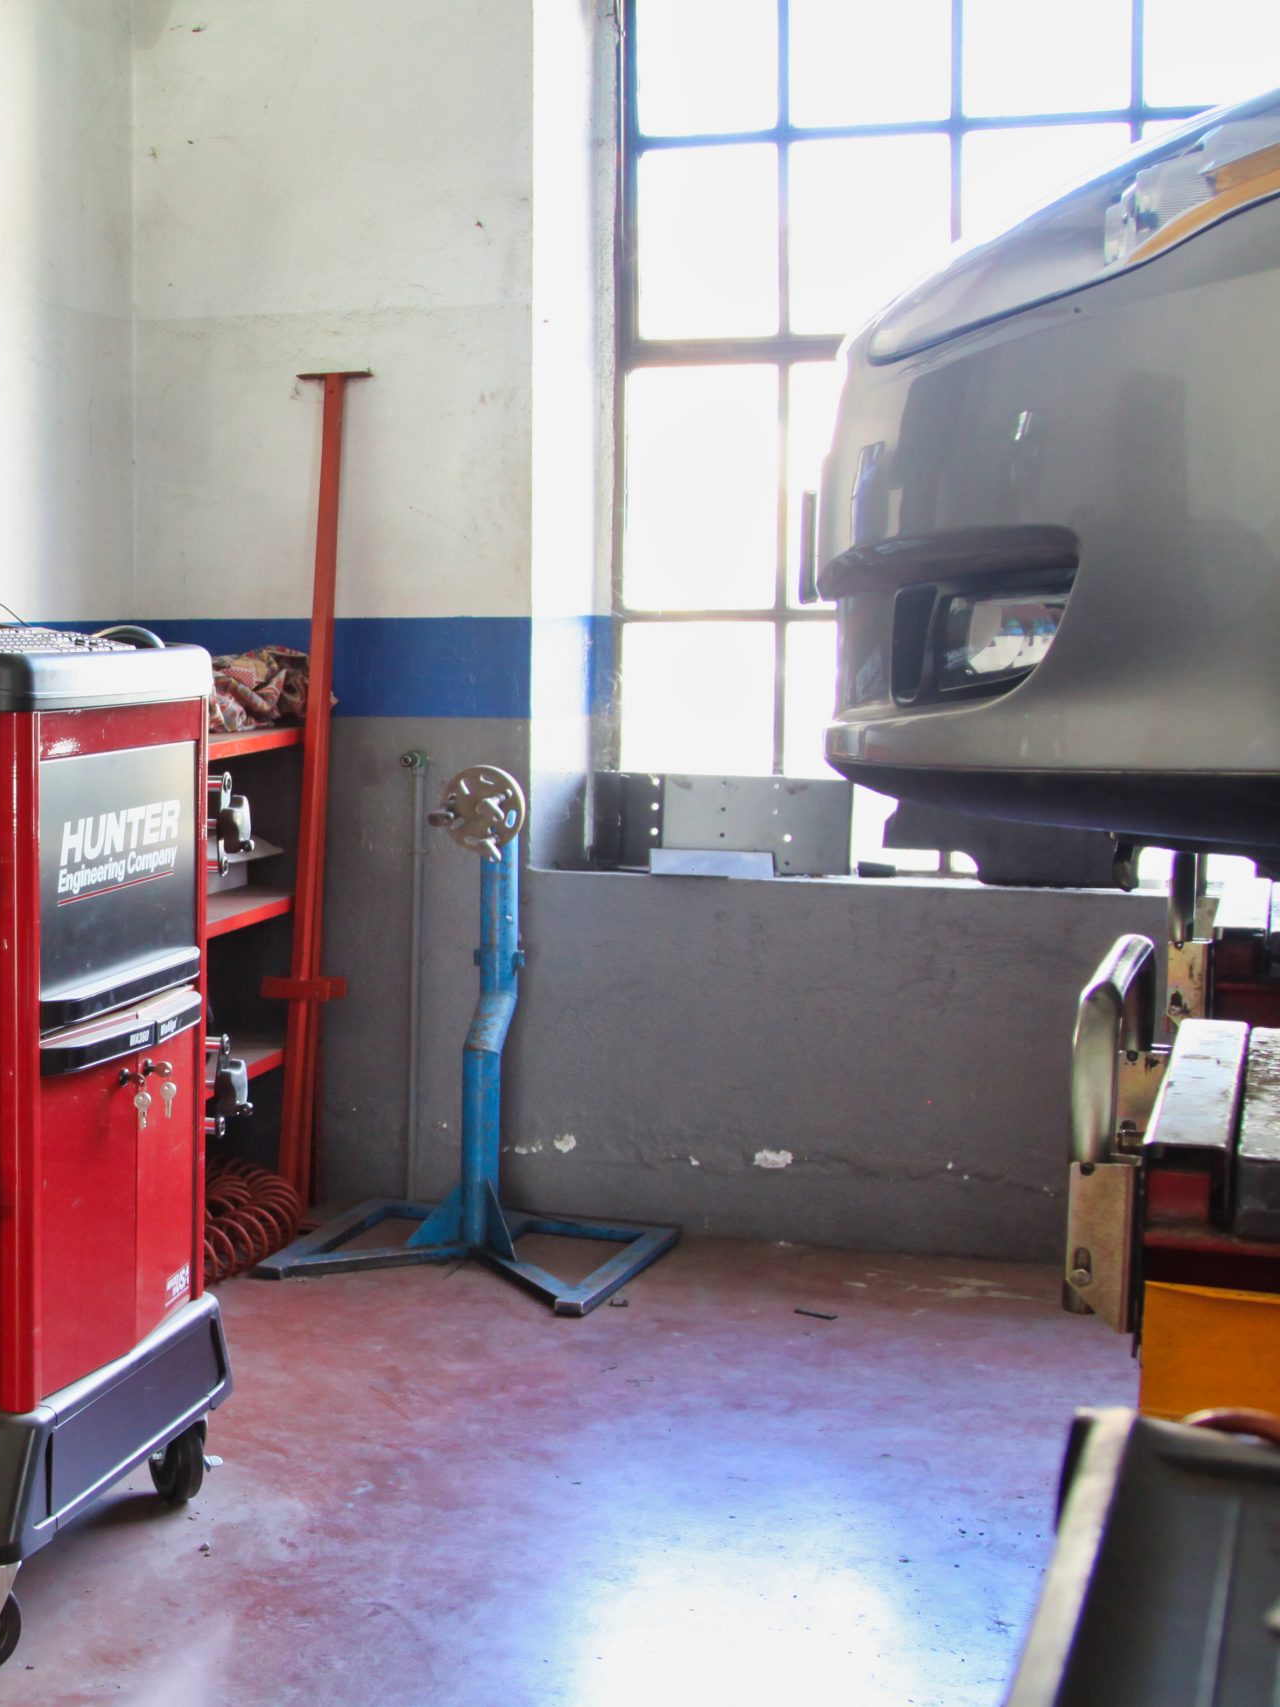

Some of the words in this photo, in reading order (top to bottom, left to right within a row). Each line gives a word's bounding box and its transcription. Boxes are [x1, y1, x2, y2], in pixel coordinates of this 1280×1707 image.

[60, 799, 181, 867] HUNTER
[58, 857, 126, 894] Engineering
[127, 845, 177, 873] Company
